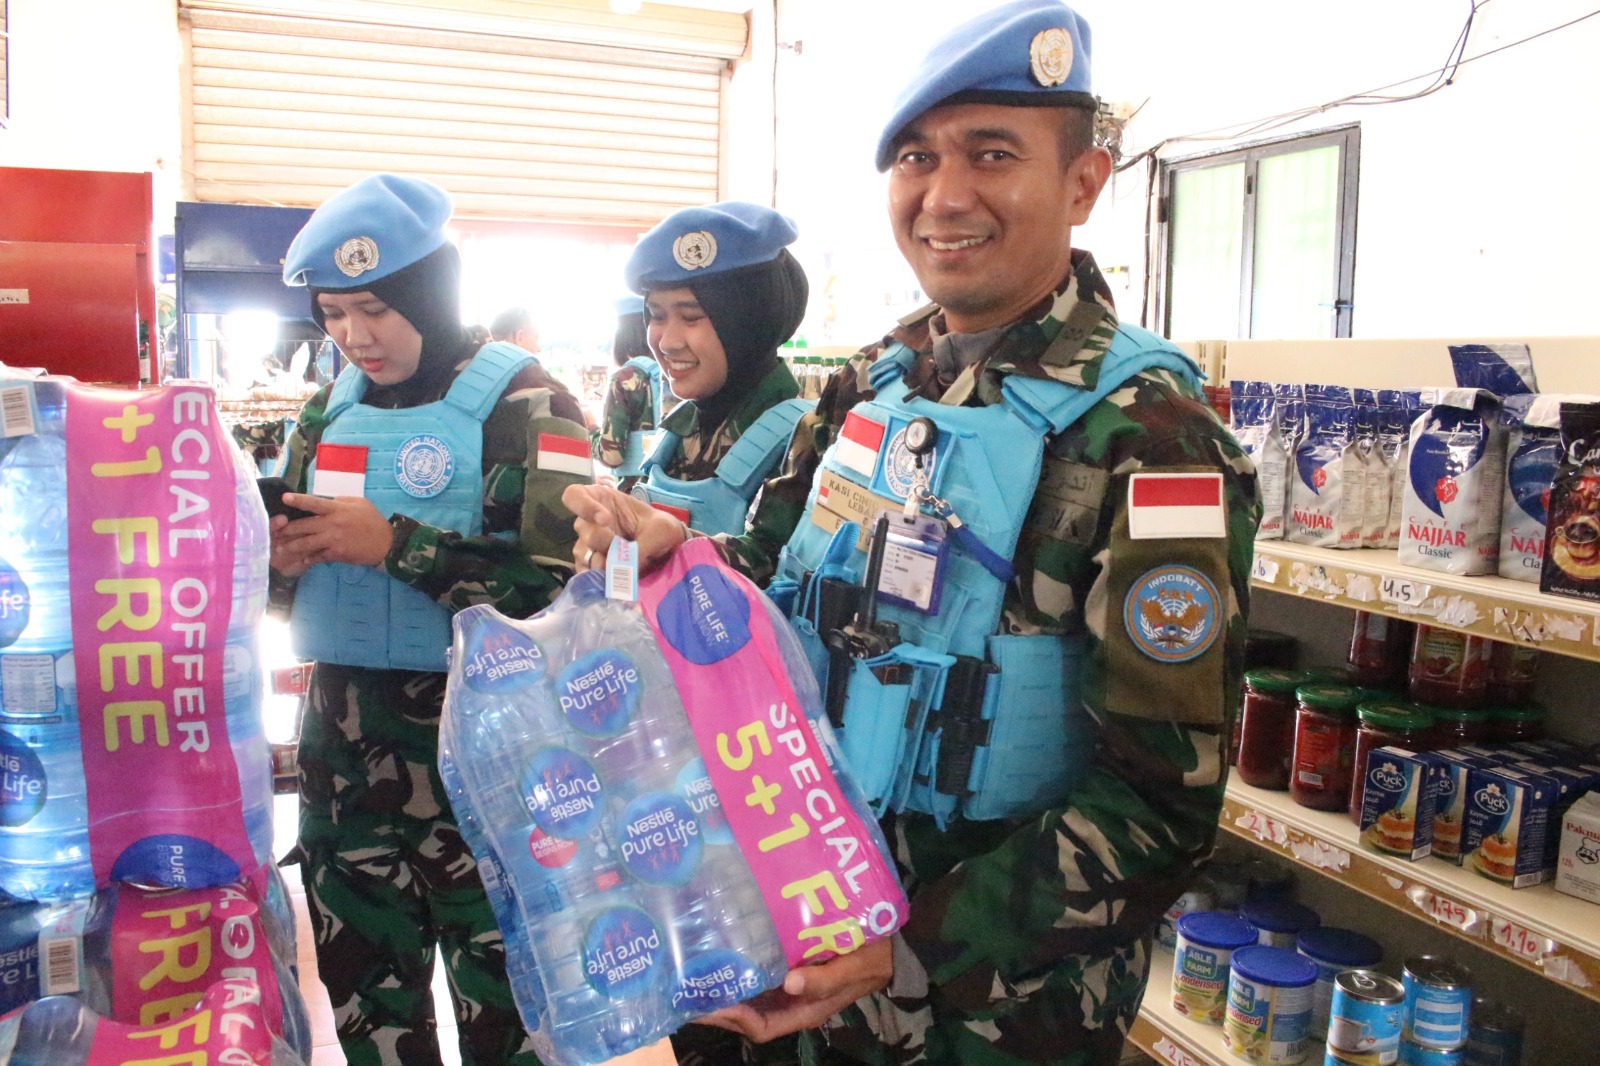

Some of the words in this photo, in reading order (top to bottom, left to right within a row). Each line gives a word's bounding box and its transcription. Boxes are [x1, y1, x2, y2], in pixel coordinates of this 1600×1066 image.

[423, 436, 451, 462] NATIONS
[828, 479, 851, 497] KASI
[1293, 511, 1334, 530] NAJJAR
[1407, 523, 1467, 548] NAJJAR
[1418, 545, 1453, 559] Classic
[1148, 574, 1203, 592] INDOBATT
[1383, 580, 1411, 601] 4.5
[689, 575, 712, 611] PURE
[706, 611, 729, 643] LIFE
[92, 517, 169, 752] FREE
[464, 651, 498, 677] Life
[496, 644, 542, 662] Pure
[170, 577, 210, 753] OFFER
[559, 686, 606, 713] Pure
[604, 668, 638, 694] Life
[3, 774, 43, 801] Life
[557, 774, 602, 797] Pure
[1376, 772, 1403, 788] Puck
[685, 794, 720, 814] ure
[769, 702, 869, 895] SPECIAL
[1480, 792, 1506, 810] Puck
[531, 836, 554, 852] PURE
[621, 832, 666, 862] Pure
[665, 819, 698, 847] Life
[169, 845, 187, 883] PURE
[616, 929, 660, 960] Pure
[587, 948, 617, 976] Life
[1186, 962, 1212, 974] FARM
[1188, 950, 1213, 964] ABLE
[1178, 972, 1224, 990] Condensed
